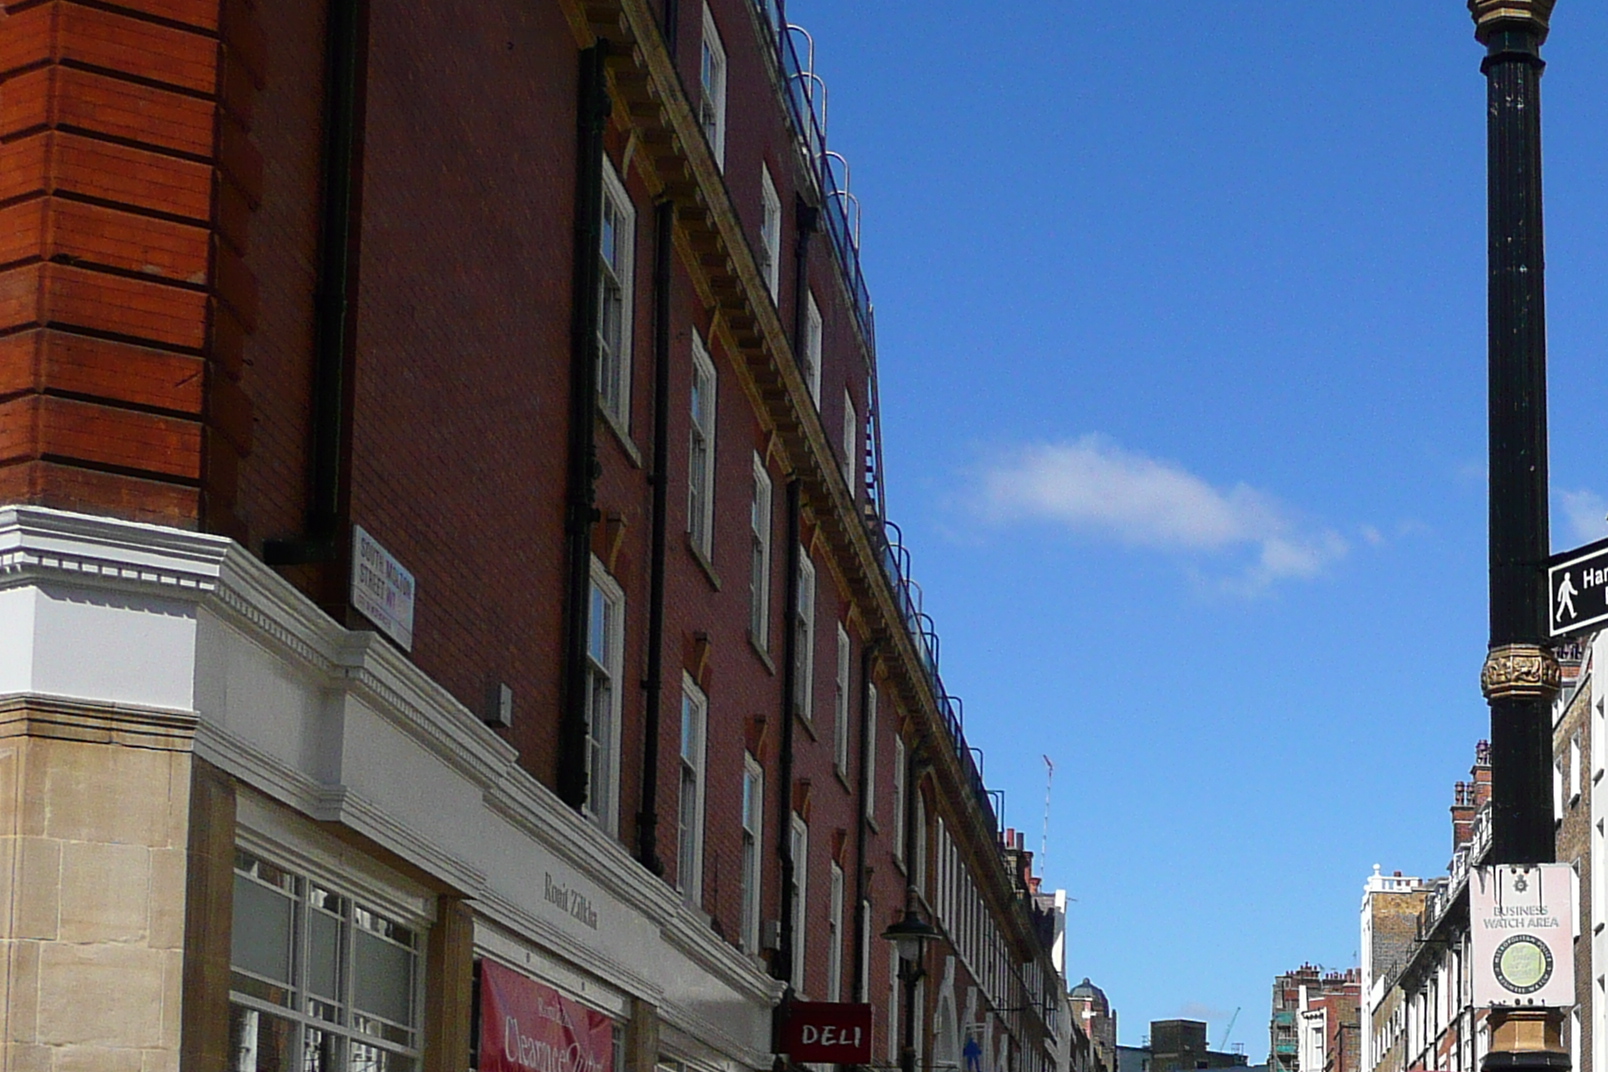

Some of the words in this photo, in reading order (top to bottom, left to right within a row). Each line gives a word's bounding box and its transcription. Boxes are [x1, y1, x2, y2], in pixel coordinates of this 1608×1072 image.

[360, 562, 386, 600] STREET
[1493, 905, 1549, 917] BUSINESS
[1482, 917, 1525, 930] WATCH
[1527, 917, 1559, 928] AREA
[802, 1024, 862, 1048] DELI
